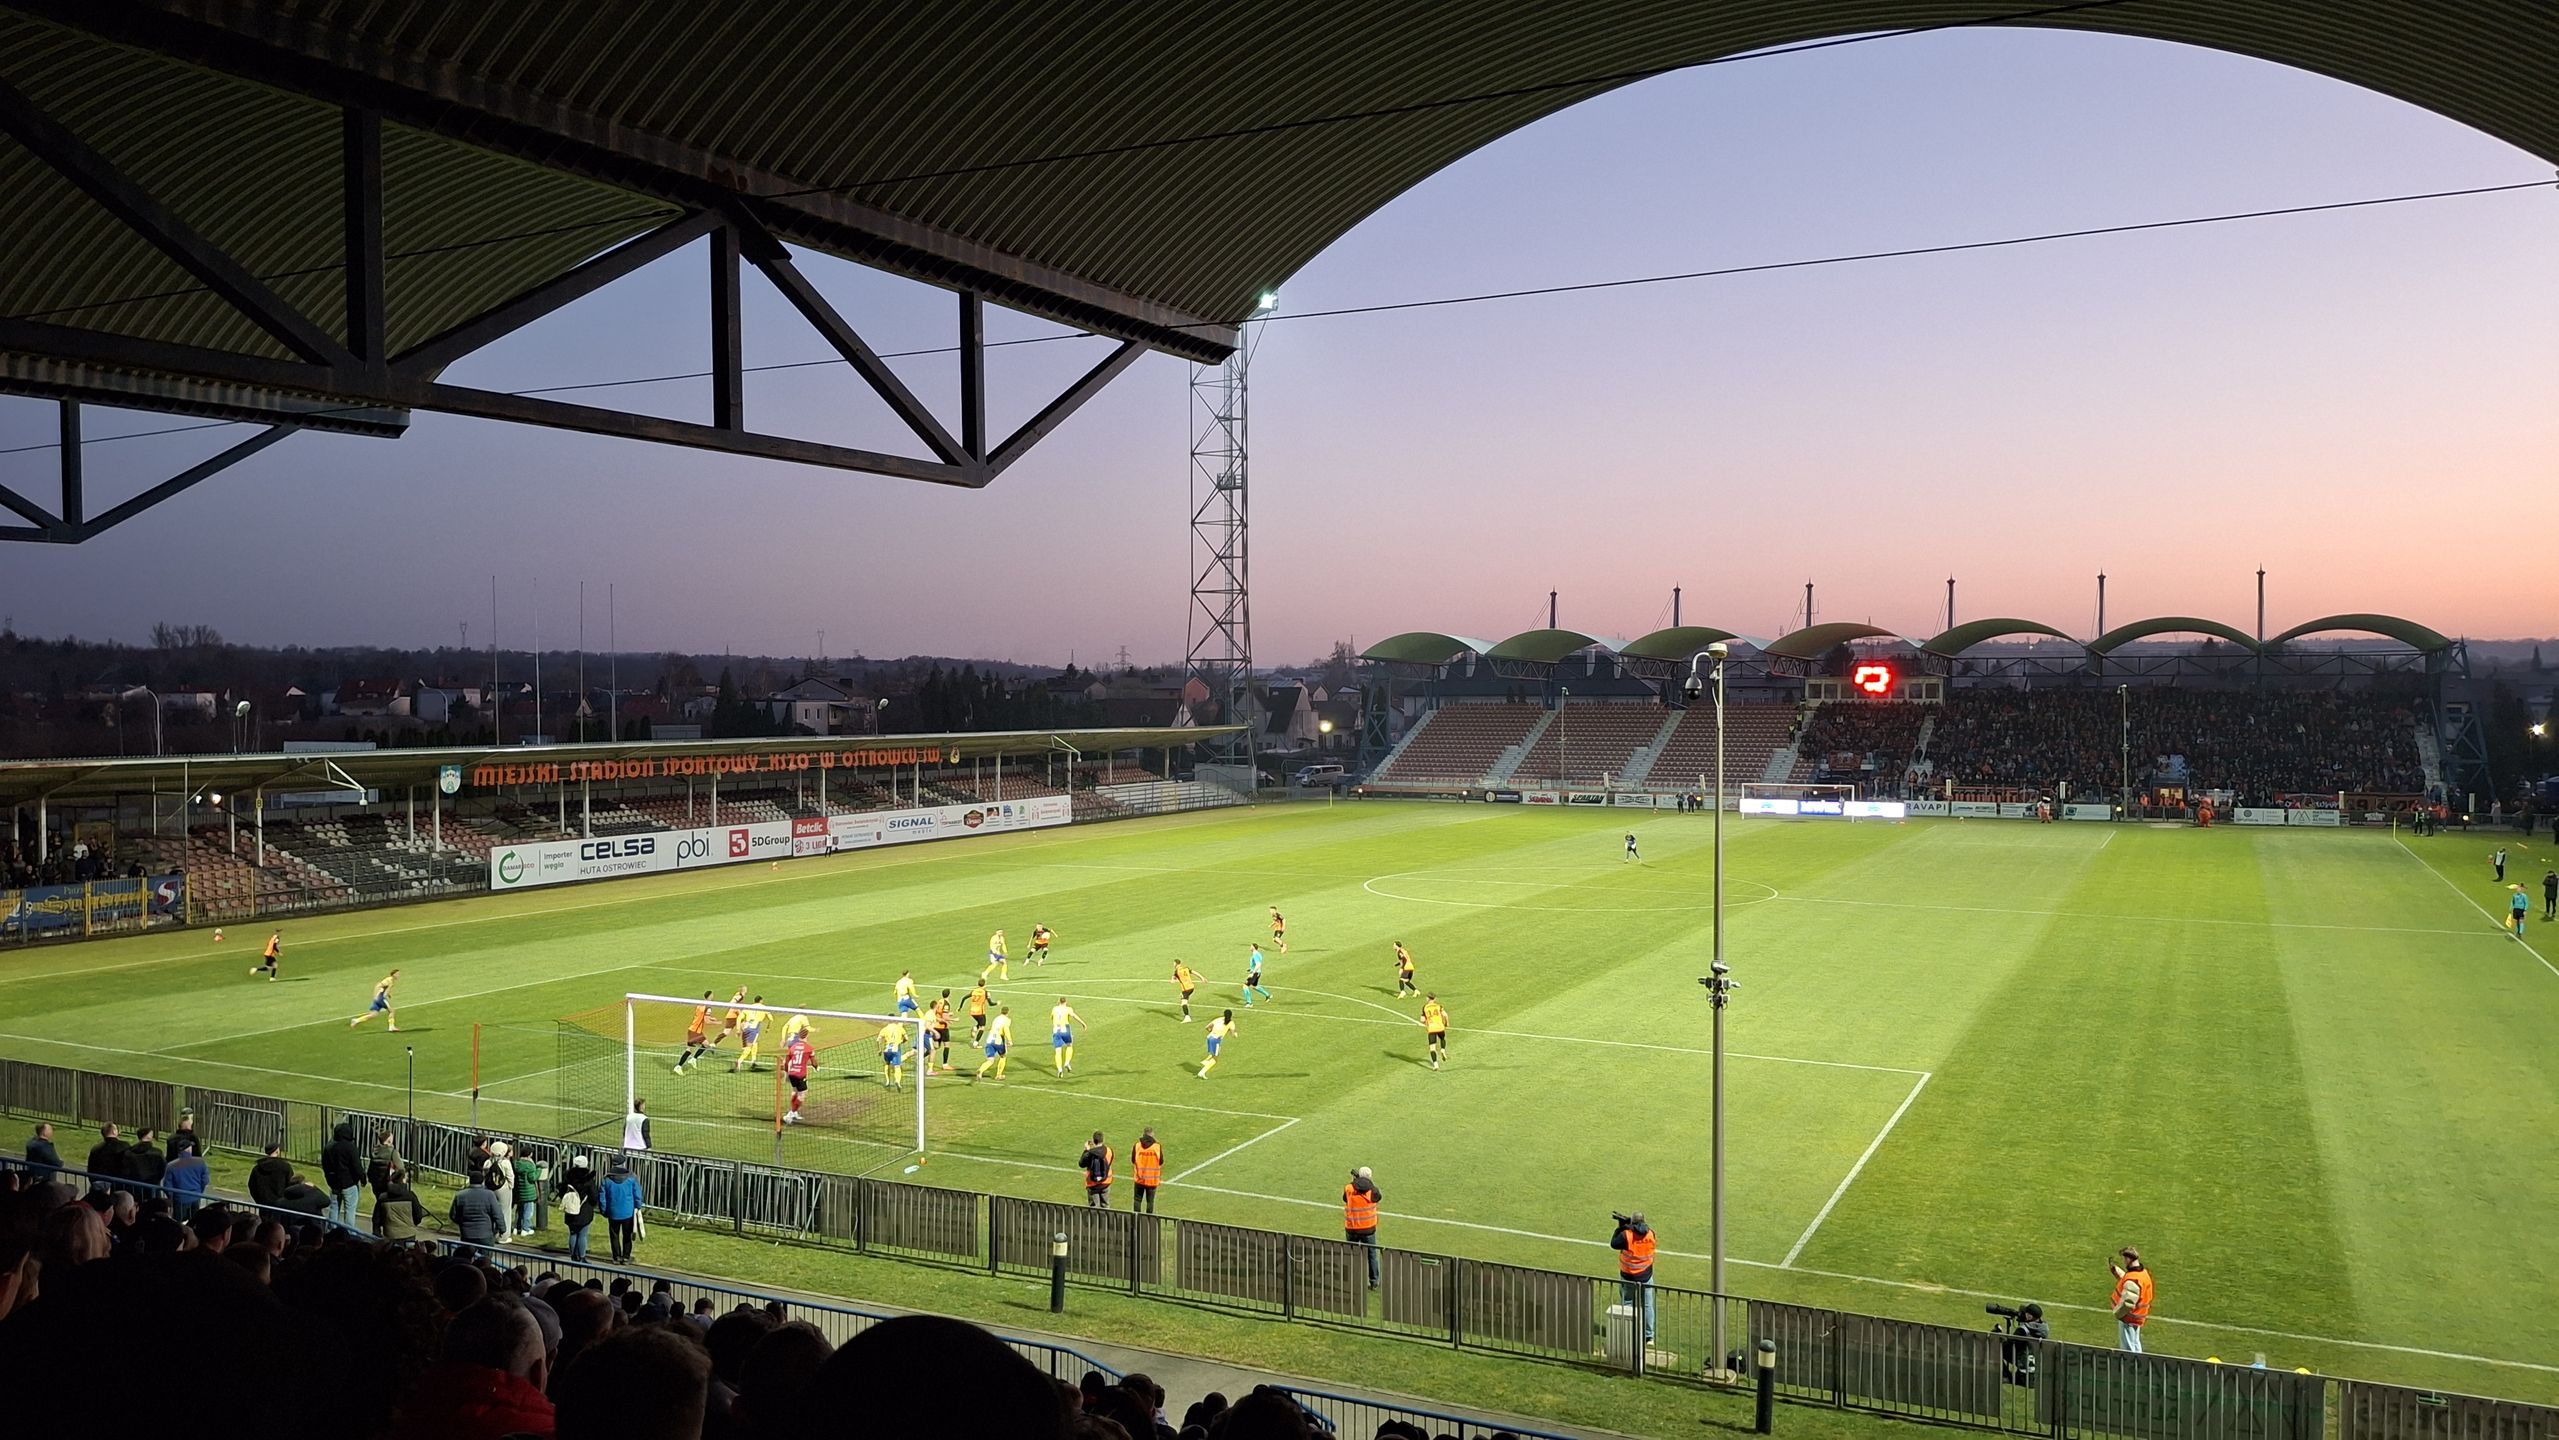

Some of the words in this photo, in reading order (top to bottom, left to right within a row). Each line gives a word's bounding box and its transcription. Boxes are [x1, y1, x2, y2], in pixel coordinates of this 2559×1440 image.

[473, 763, 559, 786] MIEJSKI
[570, 758, 654, 781] STADION
[662, 752, 759, 777] SPORTOWY
[820, 751, 835, 769] W
[842, 748, 918, 768] OSTROWCU
[1573, 793, 1605, 801] SPARTAN
[796, 822, 824, 835] Betclic
[888, 817, 934, 829] SIGNAL
[677, 830, 710, 867] pbi
[580, 866, 602, 875] HUTA
[603, 860, 647, 873] OSTROWIEC
[793, 1050, 804, 1065] 31
